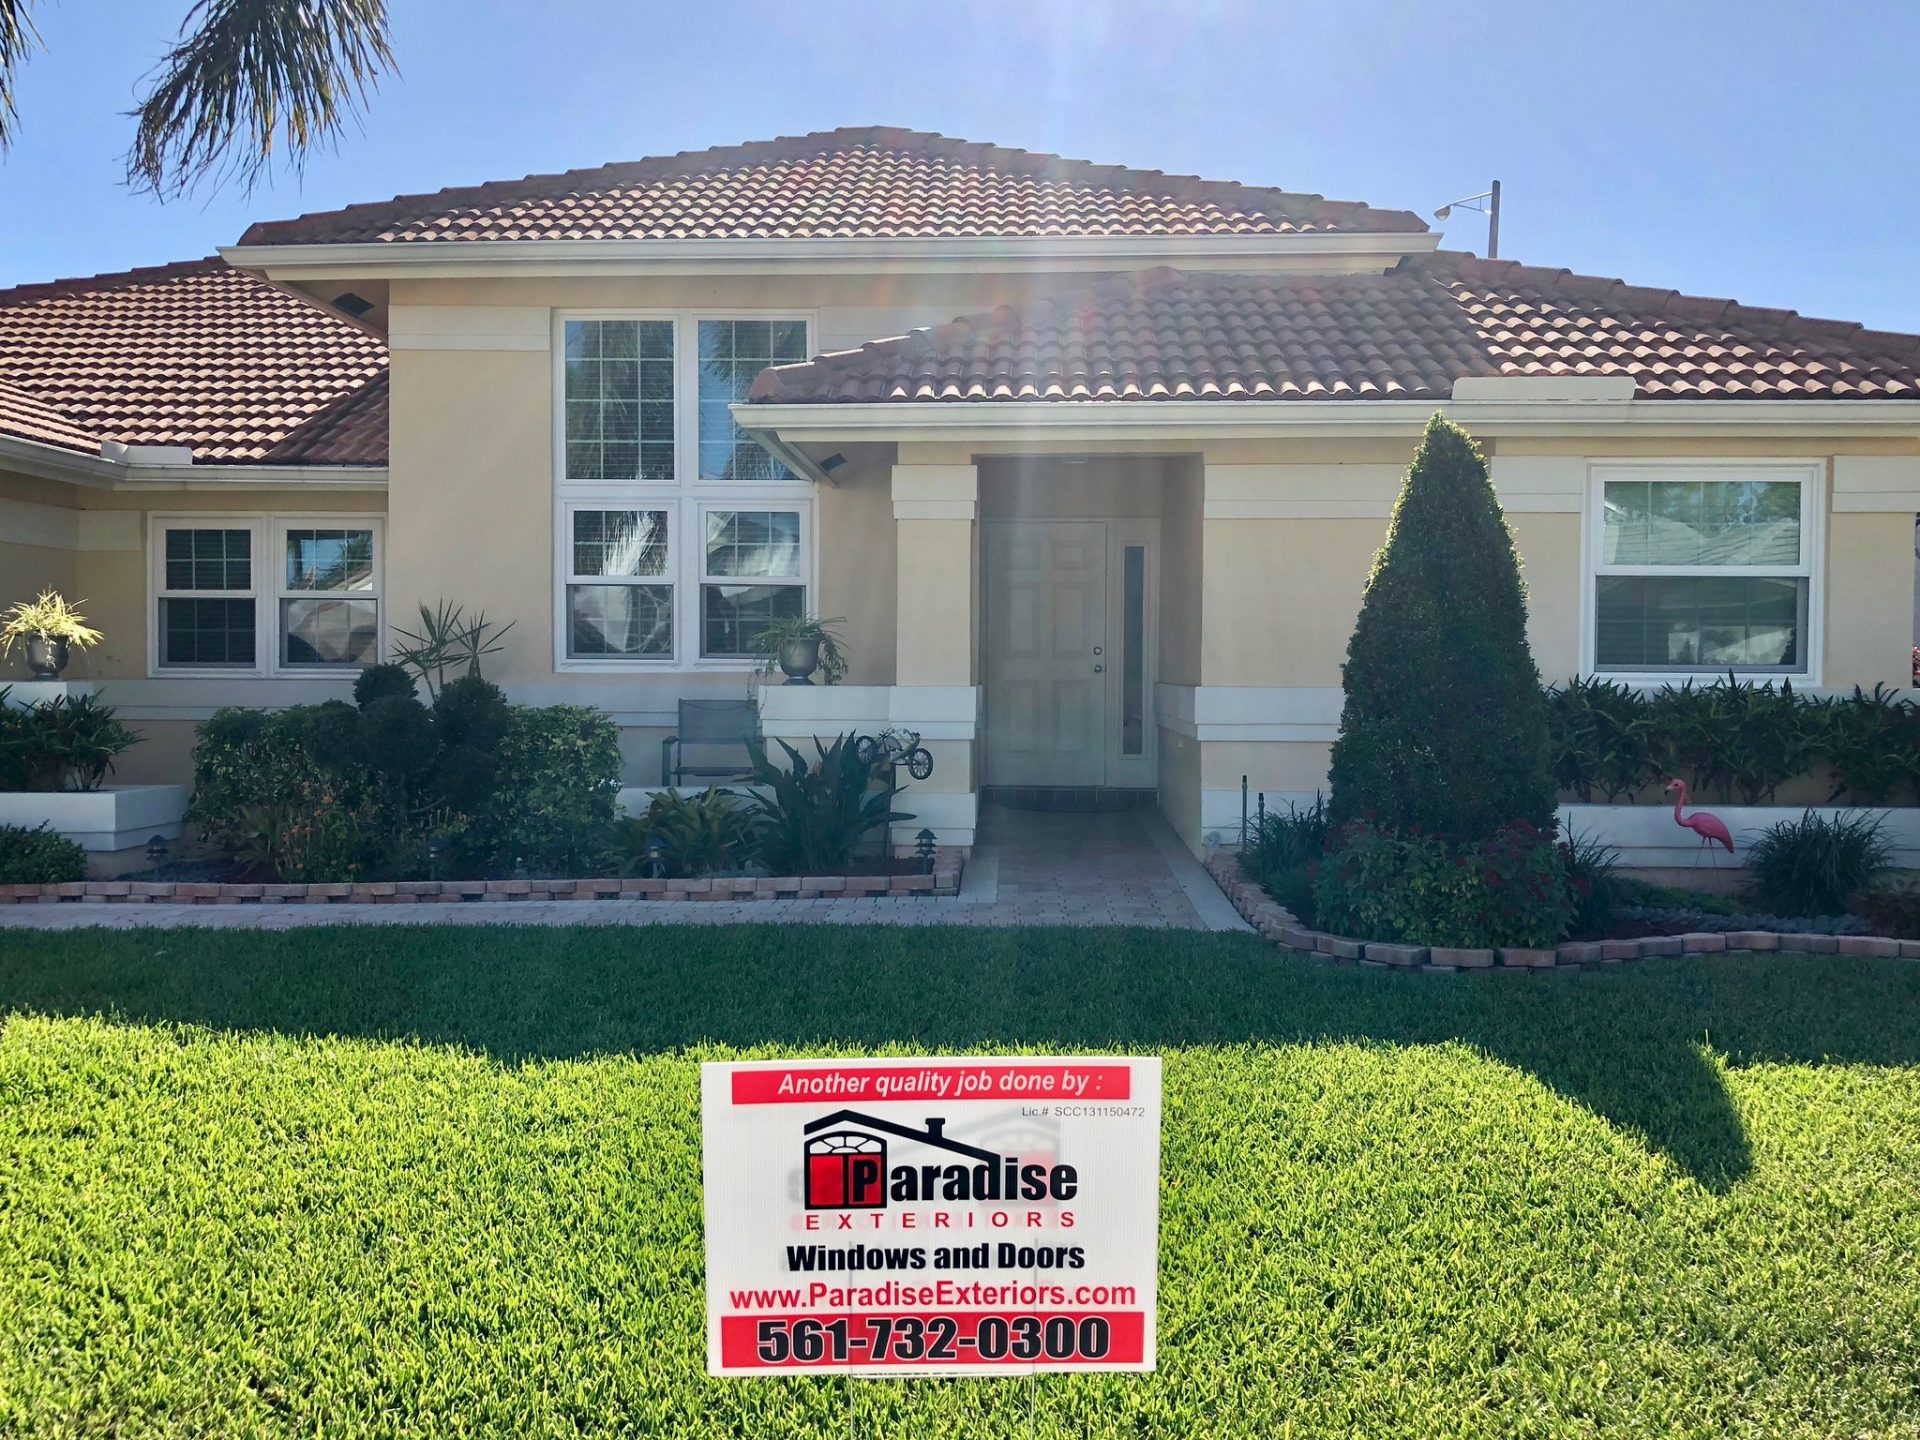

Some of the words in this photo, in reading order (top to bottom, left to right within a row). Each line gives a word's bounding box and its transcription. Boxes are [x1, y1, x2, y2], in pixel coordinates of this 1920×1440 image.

[778, 1072, 870, 1094] Another
[875, 1071, 951, 1097] quality
[954, 1070, 993, 1096] job
[999, 1070, 1055, 1091] done
[1022, 1106, 1049, 1117] Lic.#
[1054, 1106, 1145, 1117] SCC131150472
[852, 1155, 1078, 1203] Paradise
[805, 1212, 1075, 1230] EXTERIORS
[786, 1245, 926, 1271] Windows
[933, 1243, 990, 1269] and
[998, 1243, 1086, 1269] Doors
[729, 1280, 1137, 1309] www.ParadiseExteriors.com
[756, 1316, 1111, 1362] 561-732-0300
